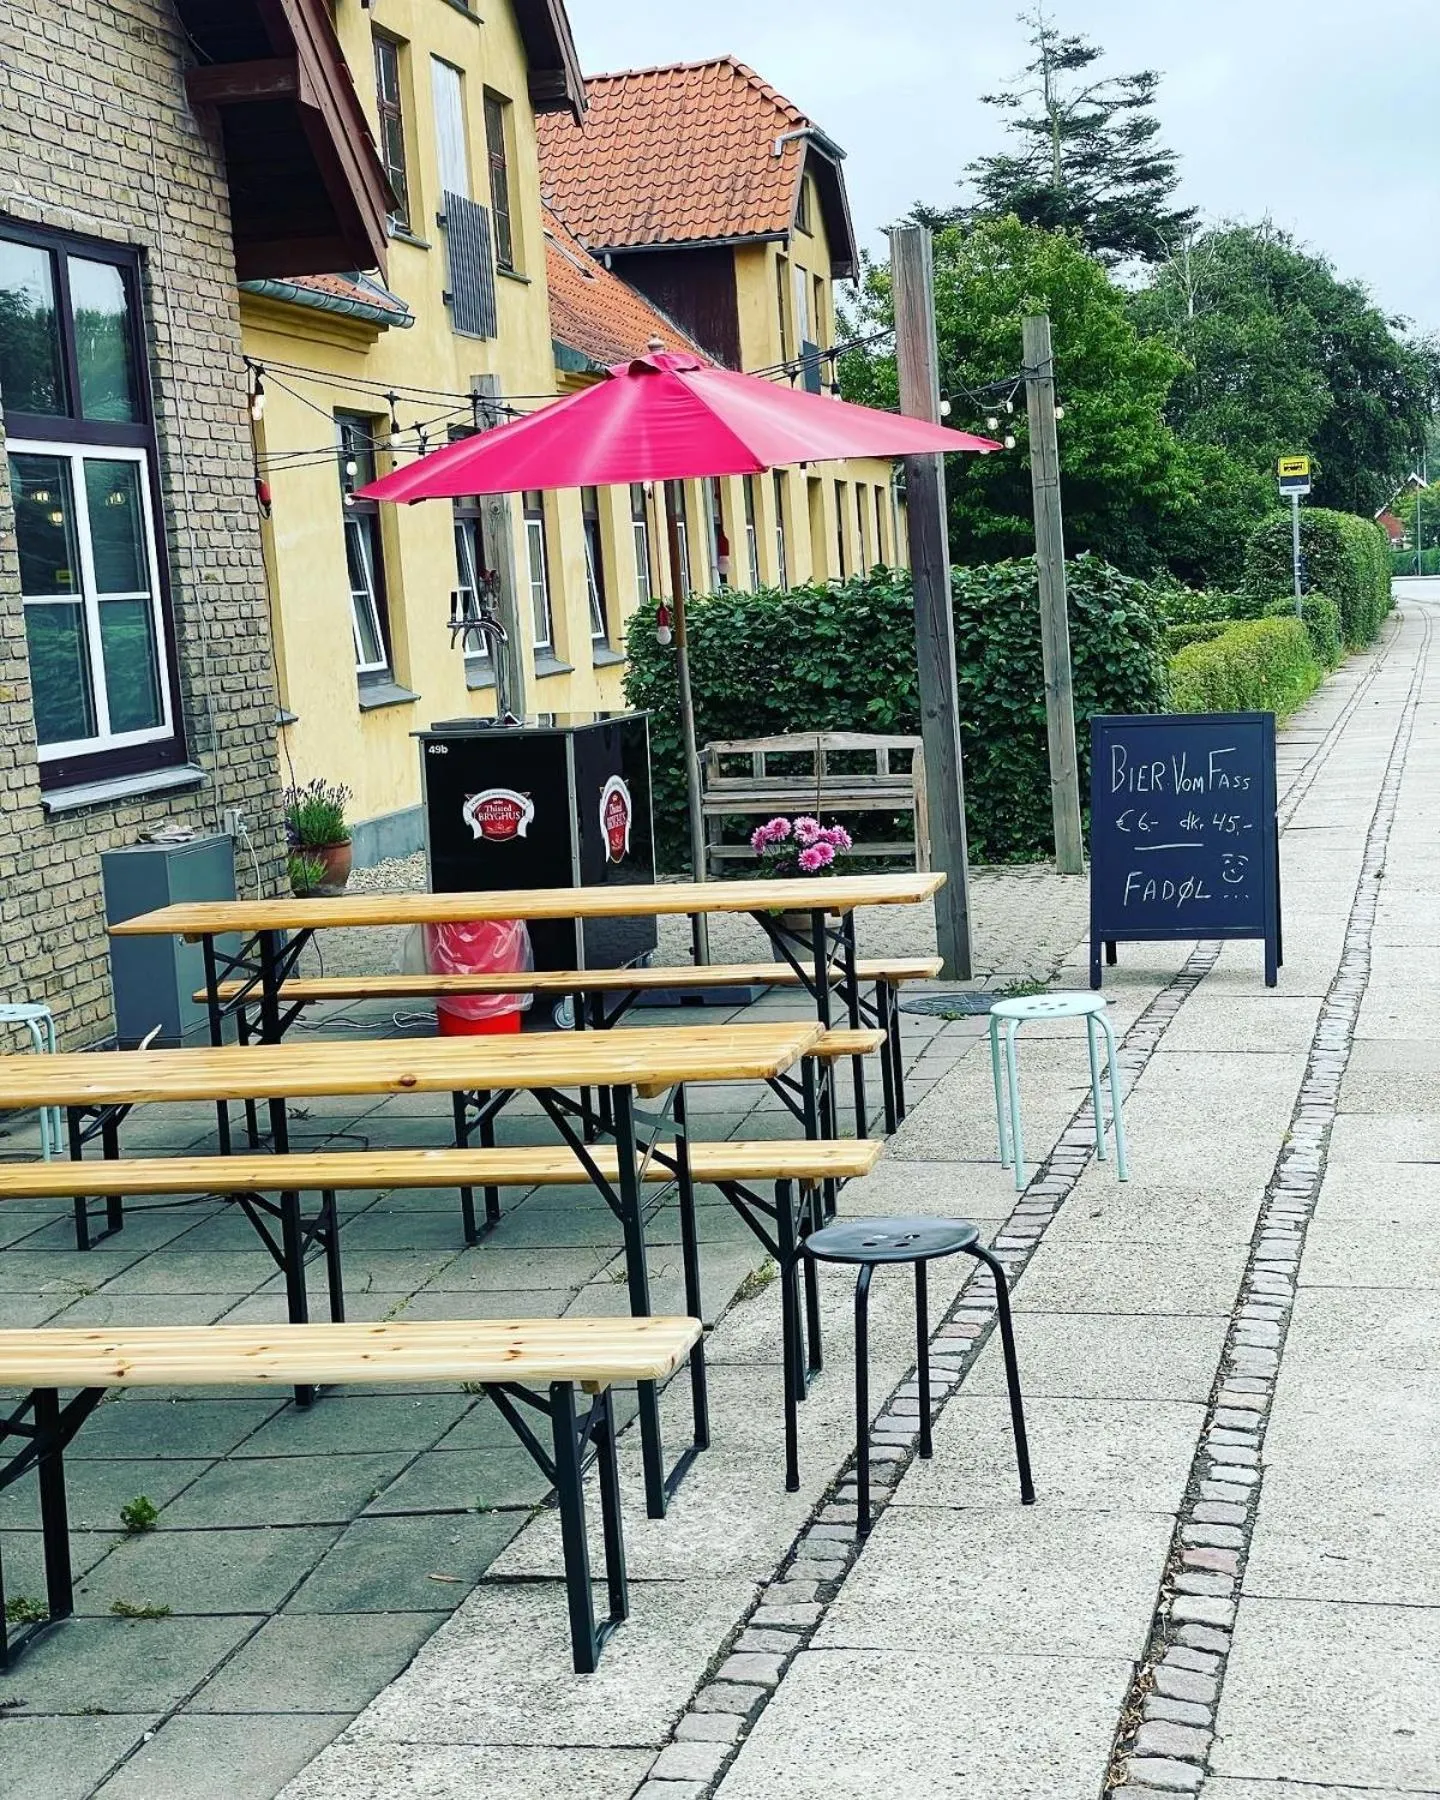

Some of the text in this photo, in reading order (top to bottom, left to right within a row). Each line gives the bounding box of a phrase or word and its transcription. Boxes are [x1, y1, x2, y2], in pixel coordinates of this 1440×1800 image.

[428, 744, 449, 755] 49b
[1111, 744, 1166, 793] BIER
[478, 811, 521, 821] BRYGHUS
